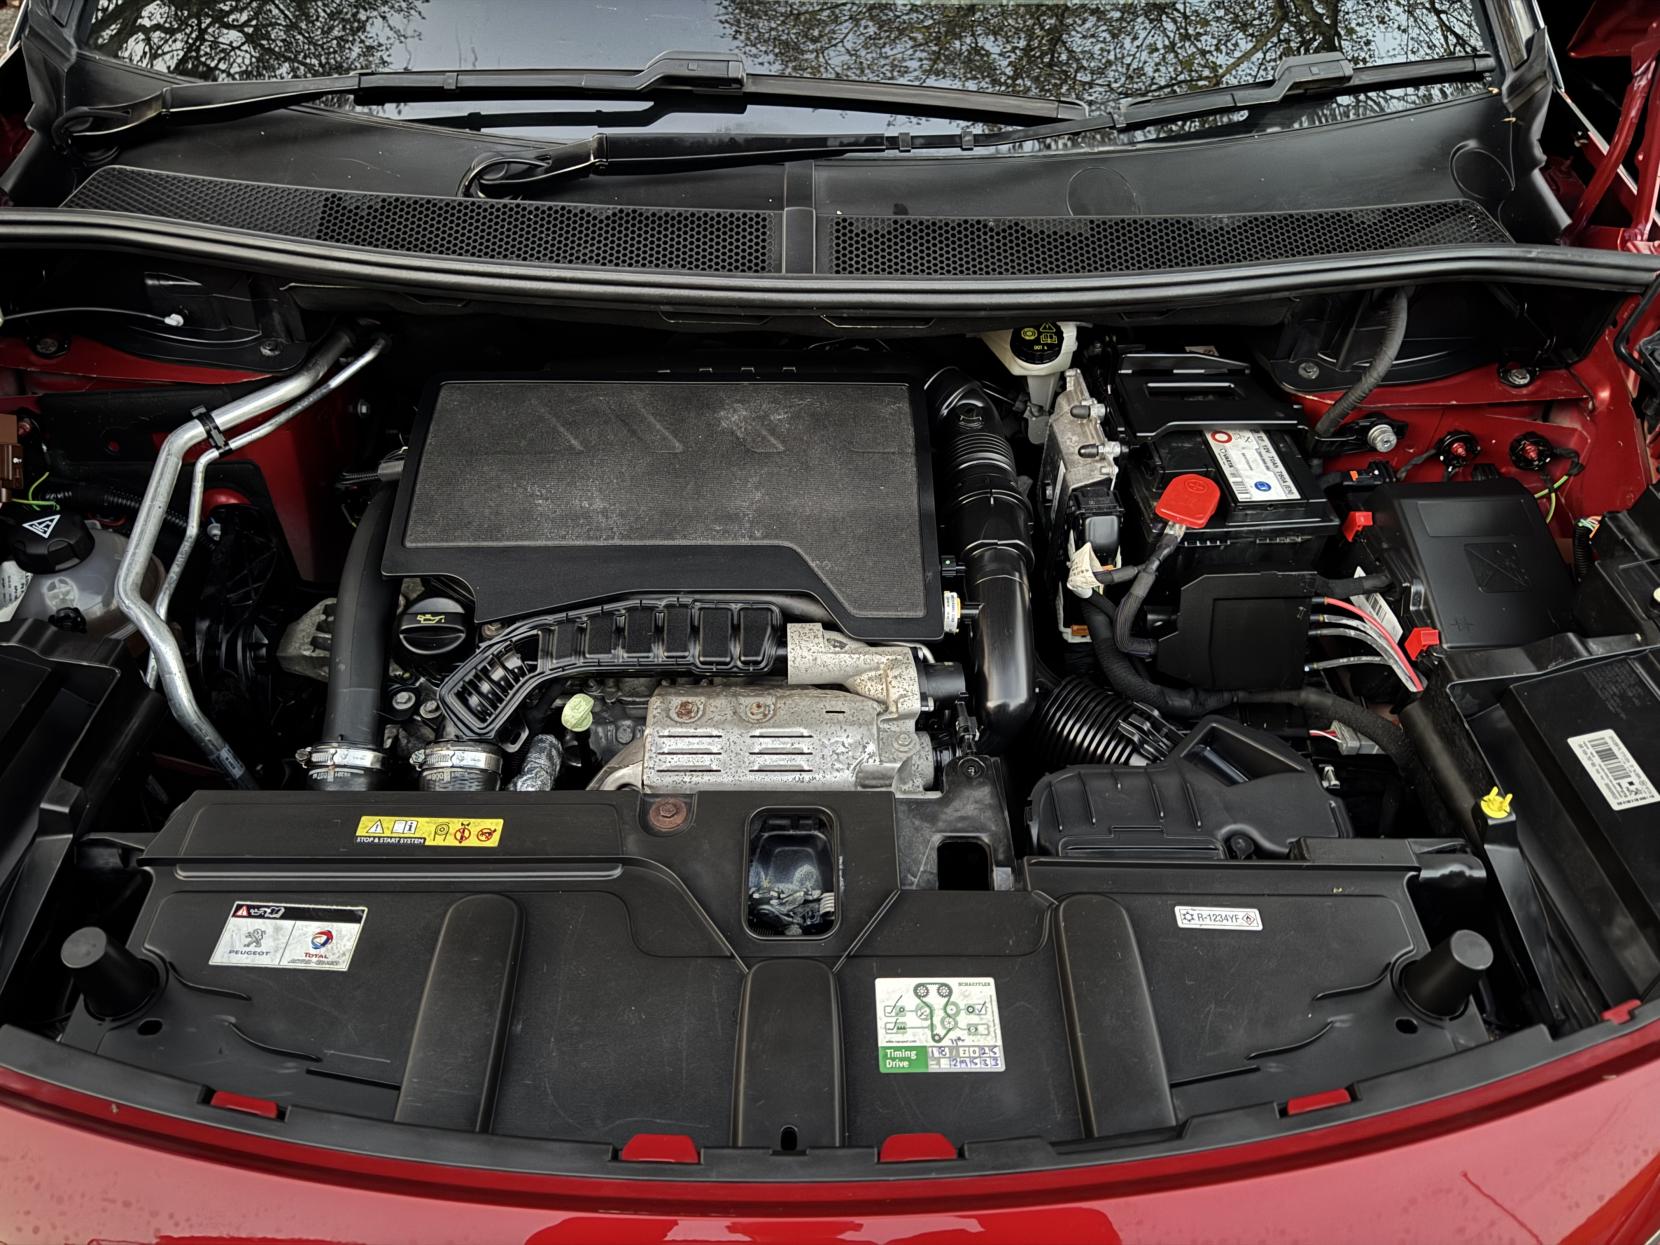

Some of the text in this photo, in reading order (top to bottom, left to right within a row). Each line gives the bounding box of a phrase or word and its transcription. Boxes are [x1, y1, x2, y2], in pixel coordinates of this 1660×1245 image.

[1268, 456, 1279, 468] 70Ah
[1276, 471, 1288, 484] 760A
[1197, 913, 1240, 923] R-1234YF
[885, 1049, 917, 1059] Timing
[886, 1059, 909, 1068] Drive
